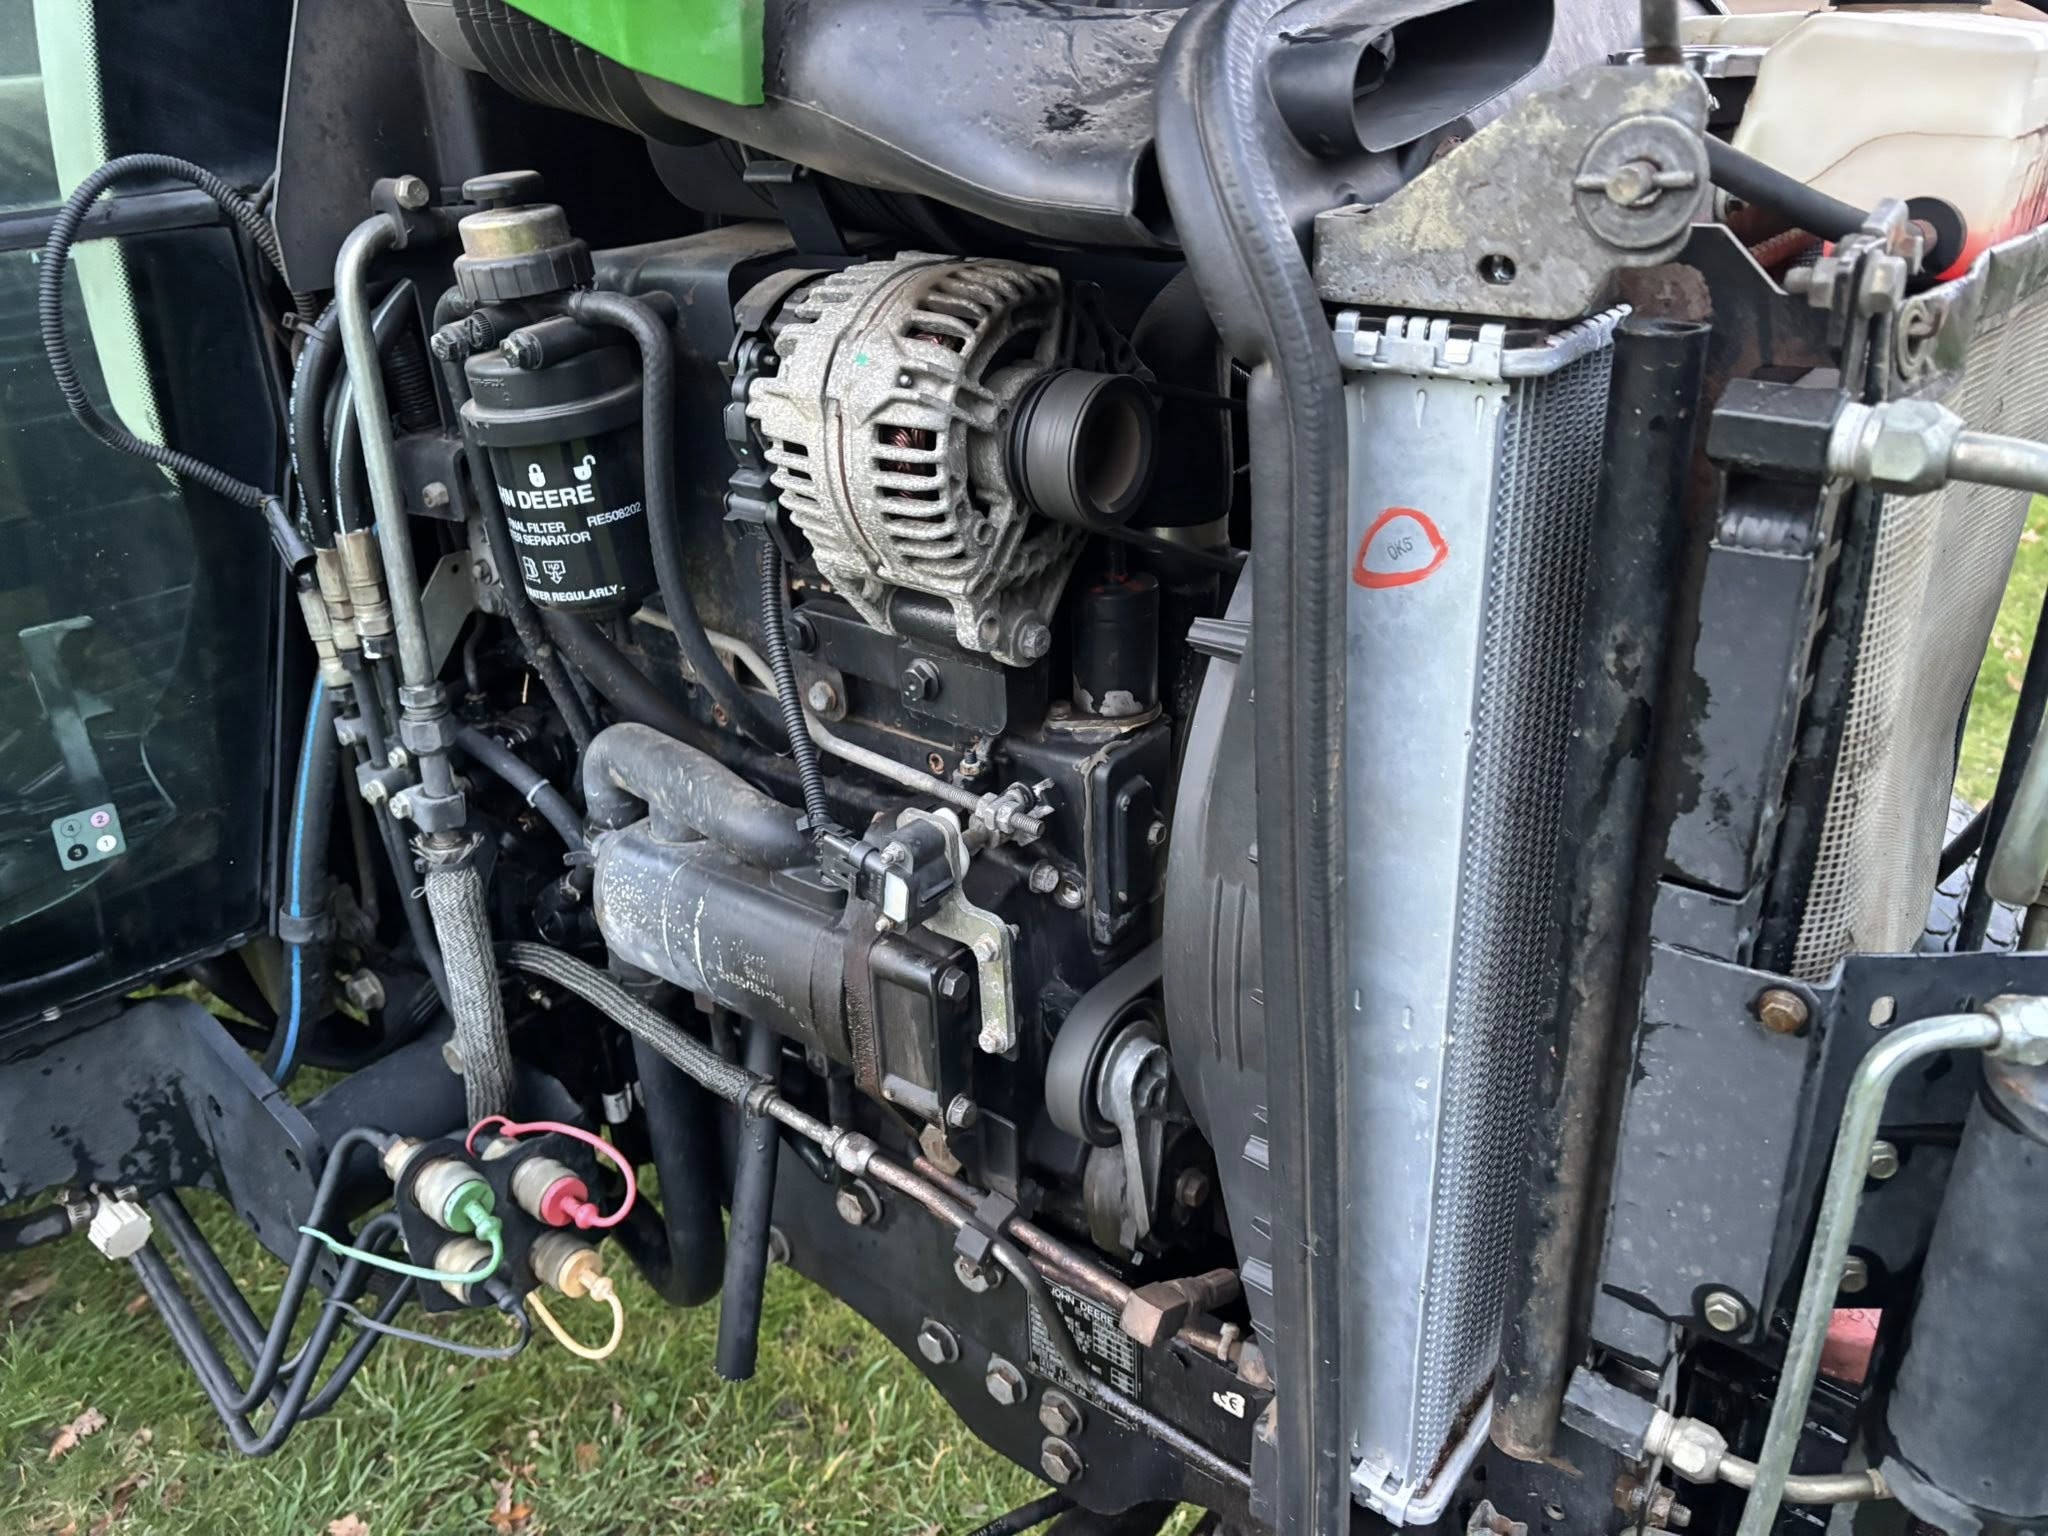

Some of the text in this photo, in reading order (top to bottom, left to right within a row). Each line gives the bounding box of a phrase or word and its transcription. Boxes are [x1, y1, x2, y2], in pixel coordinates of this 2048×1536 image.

[498, 484, 595, 509] HN DEERE
[587, 502, 642, 527] RE508202
[527, 521, 566, 534] FILTER
[523, 531, 592, 546] SEPARATOR
[552, 584, 618, 602] REGULARLY
[96, 814, 105, 824] 2
[73, 848, 83, 858] 3
[1051, 1287, 1114, 1327] JOHN DEERE
